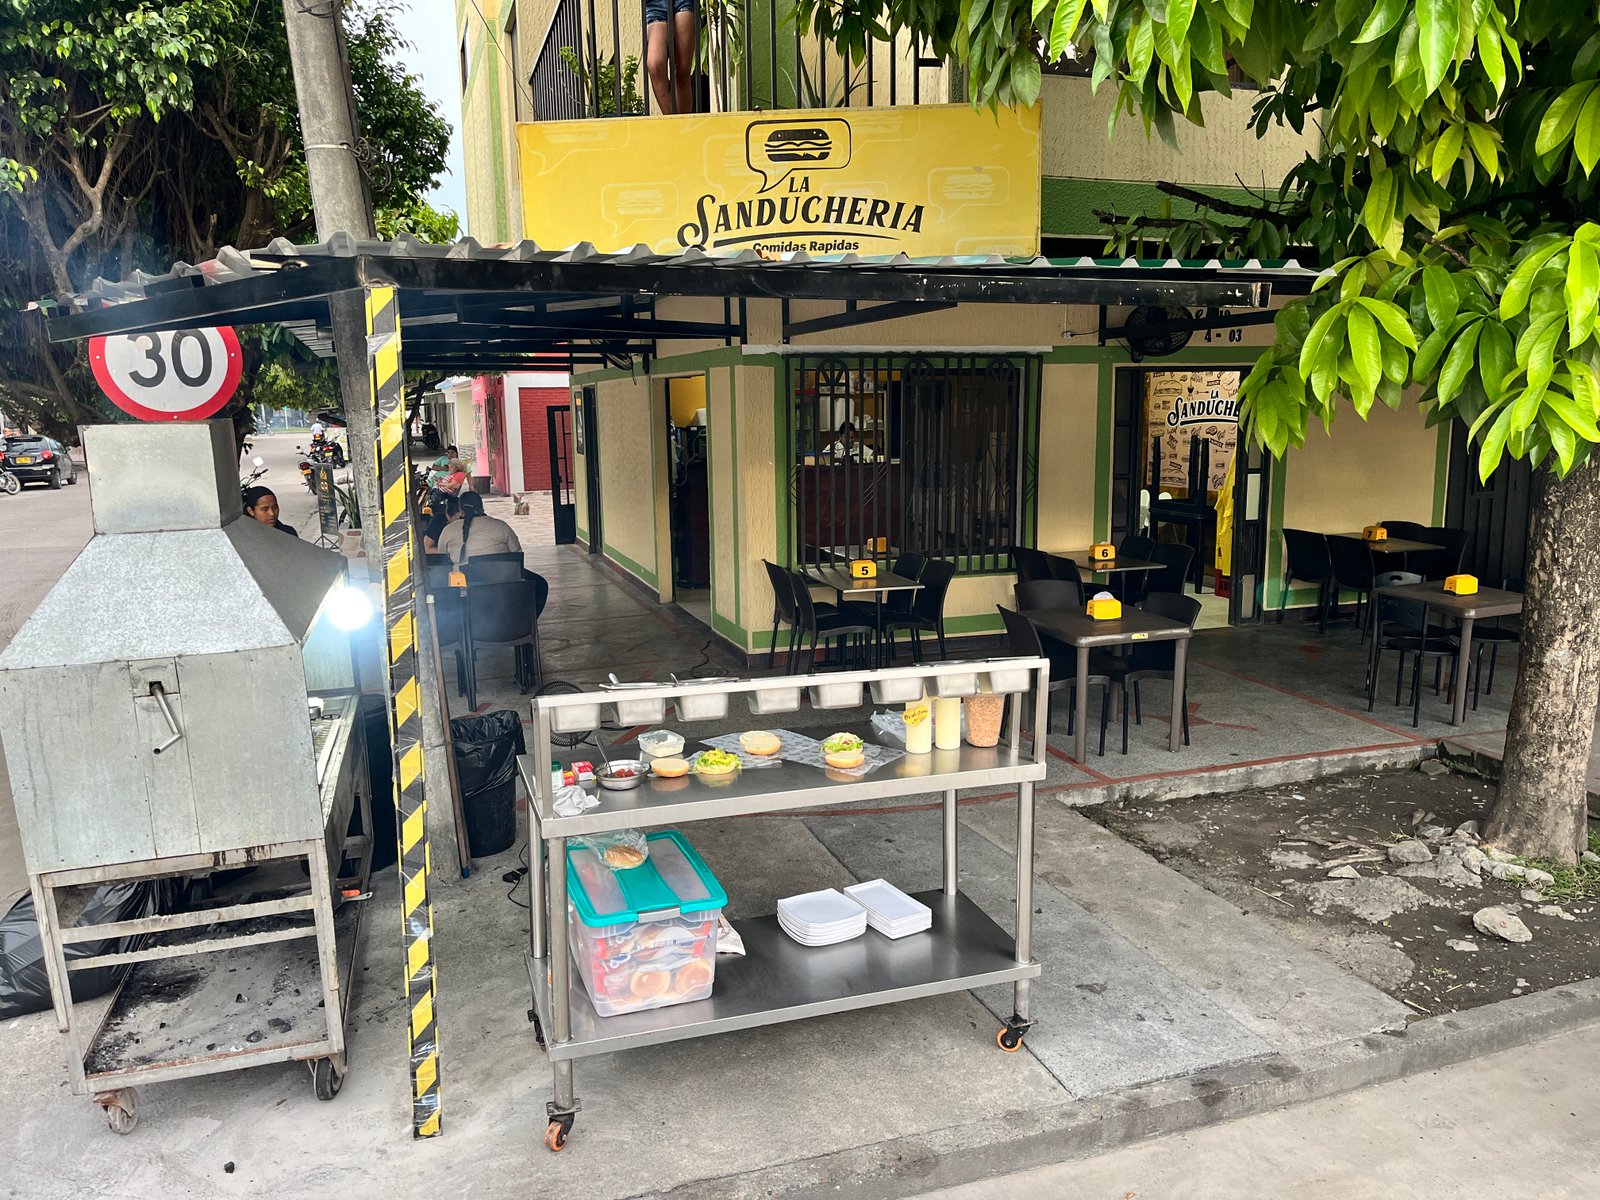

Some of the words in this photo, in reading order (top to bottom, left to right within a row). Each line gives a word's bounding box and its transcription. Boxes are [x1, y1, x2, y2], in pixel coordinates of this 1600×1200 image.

[788, 175, 811, 193] LA
[677, 194, 926, 251] SANDUCHERIA
[752, 241, 807, 253] Comidas
[808, 239, 860, 254] Rapidas
[1228, 329, 1243, 343] 03
[127, 328, 213, 388] 30
[1210, 389, 1220, 399] LA
[1167, 397, 1240, 427] SANDUCHE
[1101, 548, 1109, 558] 6
[861, 566, 869, 576] 5
